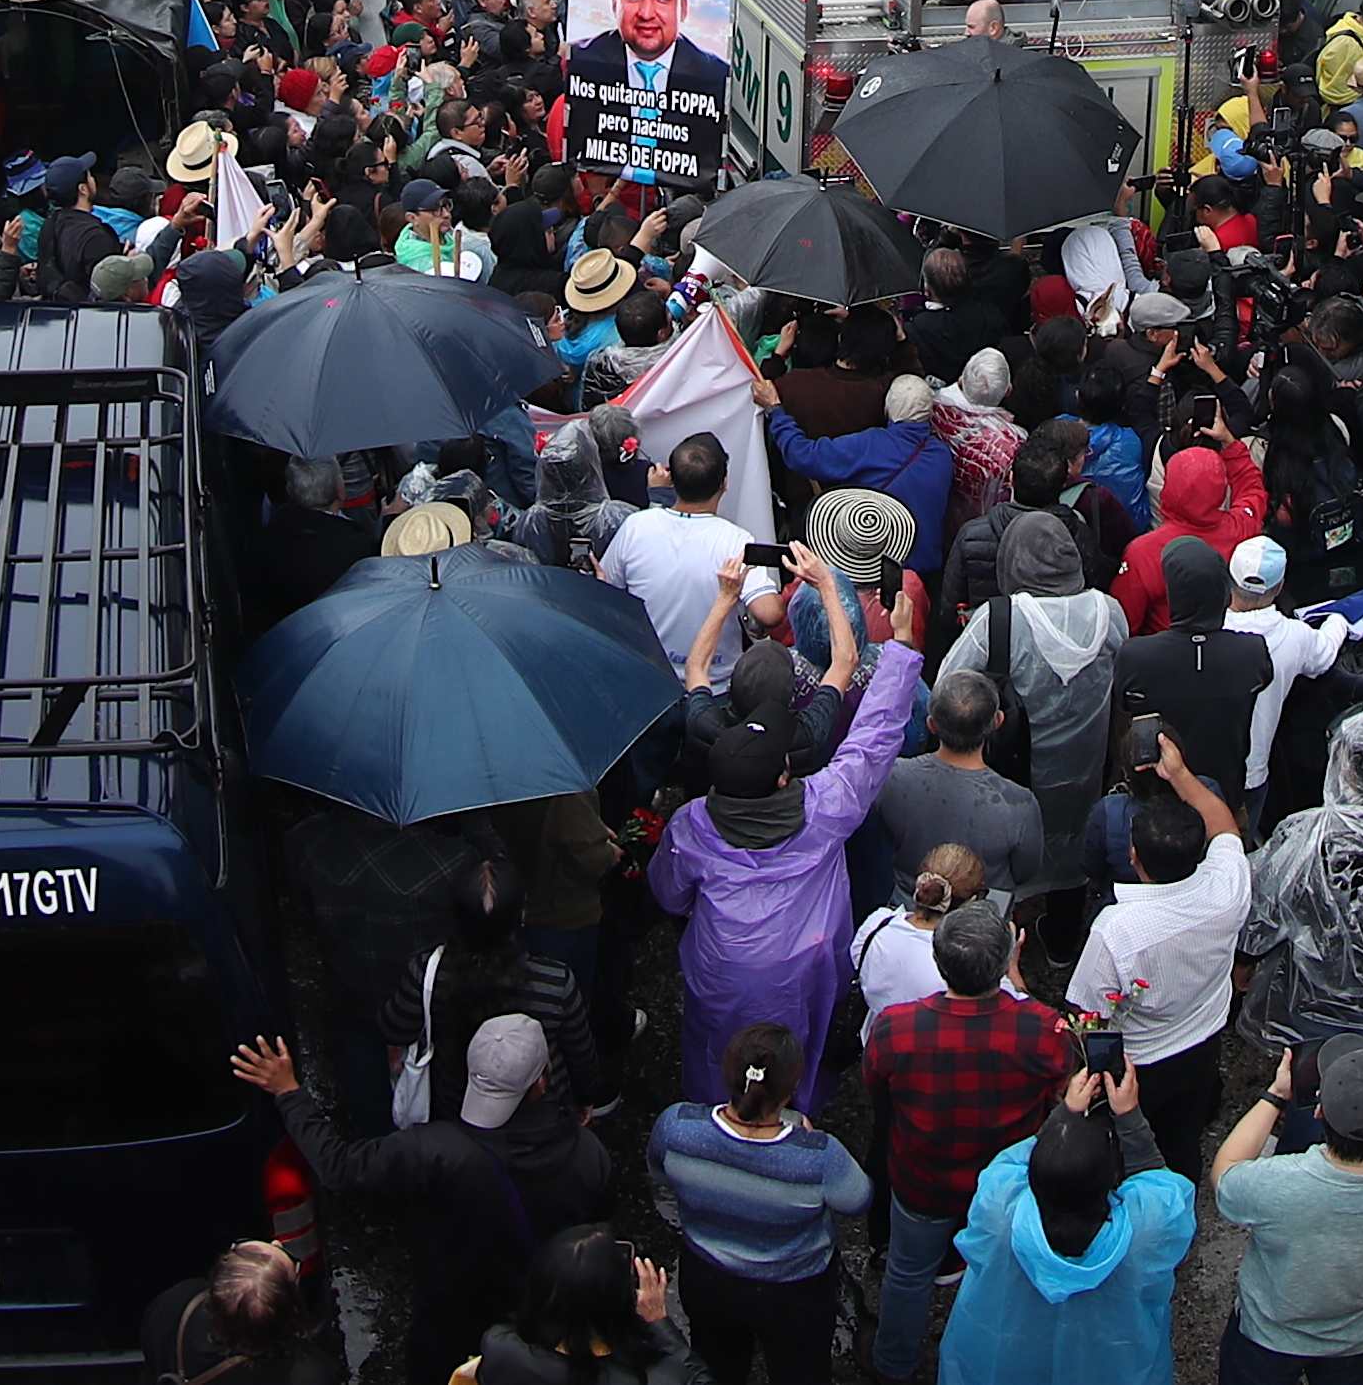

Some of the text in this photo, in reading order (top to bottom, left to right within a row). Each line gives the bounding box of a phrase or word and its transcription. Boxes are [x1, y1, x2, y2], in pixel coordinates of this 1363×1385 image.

[569, 75, 720, 123] Nos quitaron a FOPPA,
[777, 70, 792, 143] 9
[598, 113, 689, 142] pero nacimos
[585, 138, 698, 177] MILES DE FOPPA
